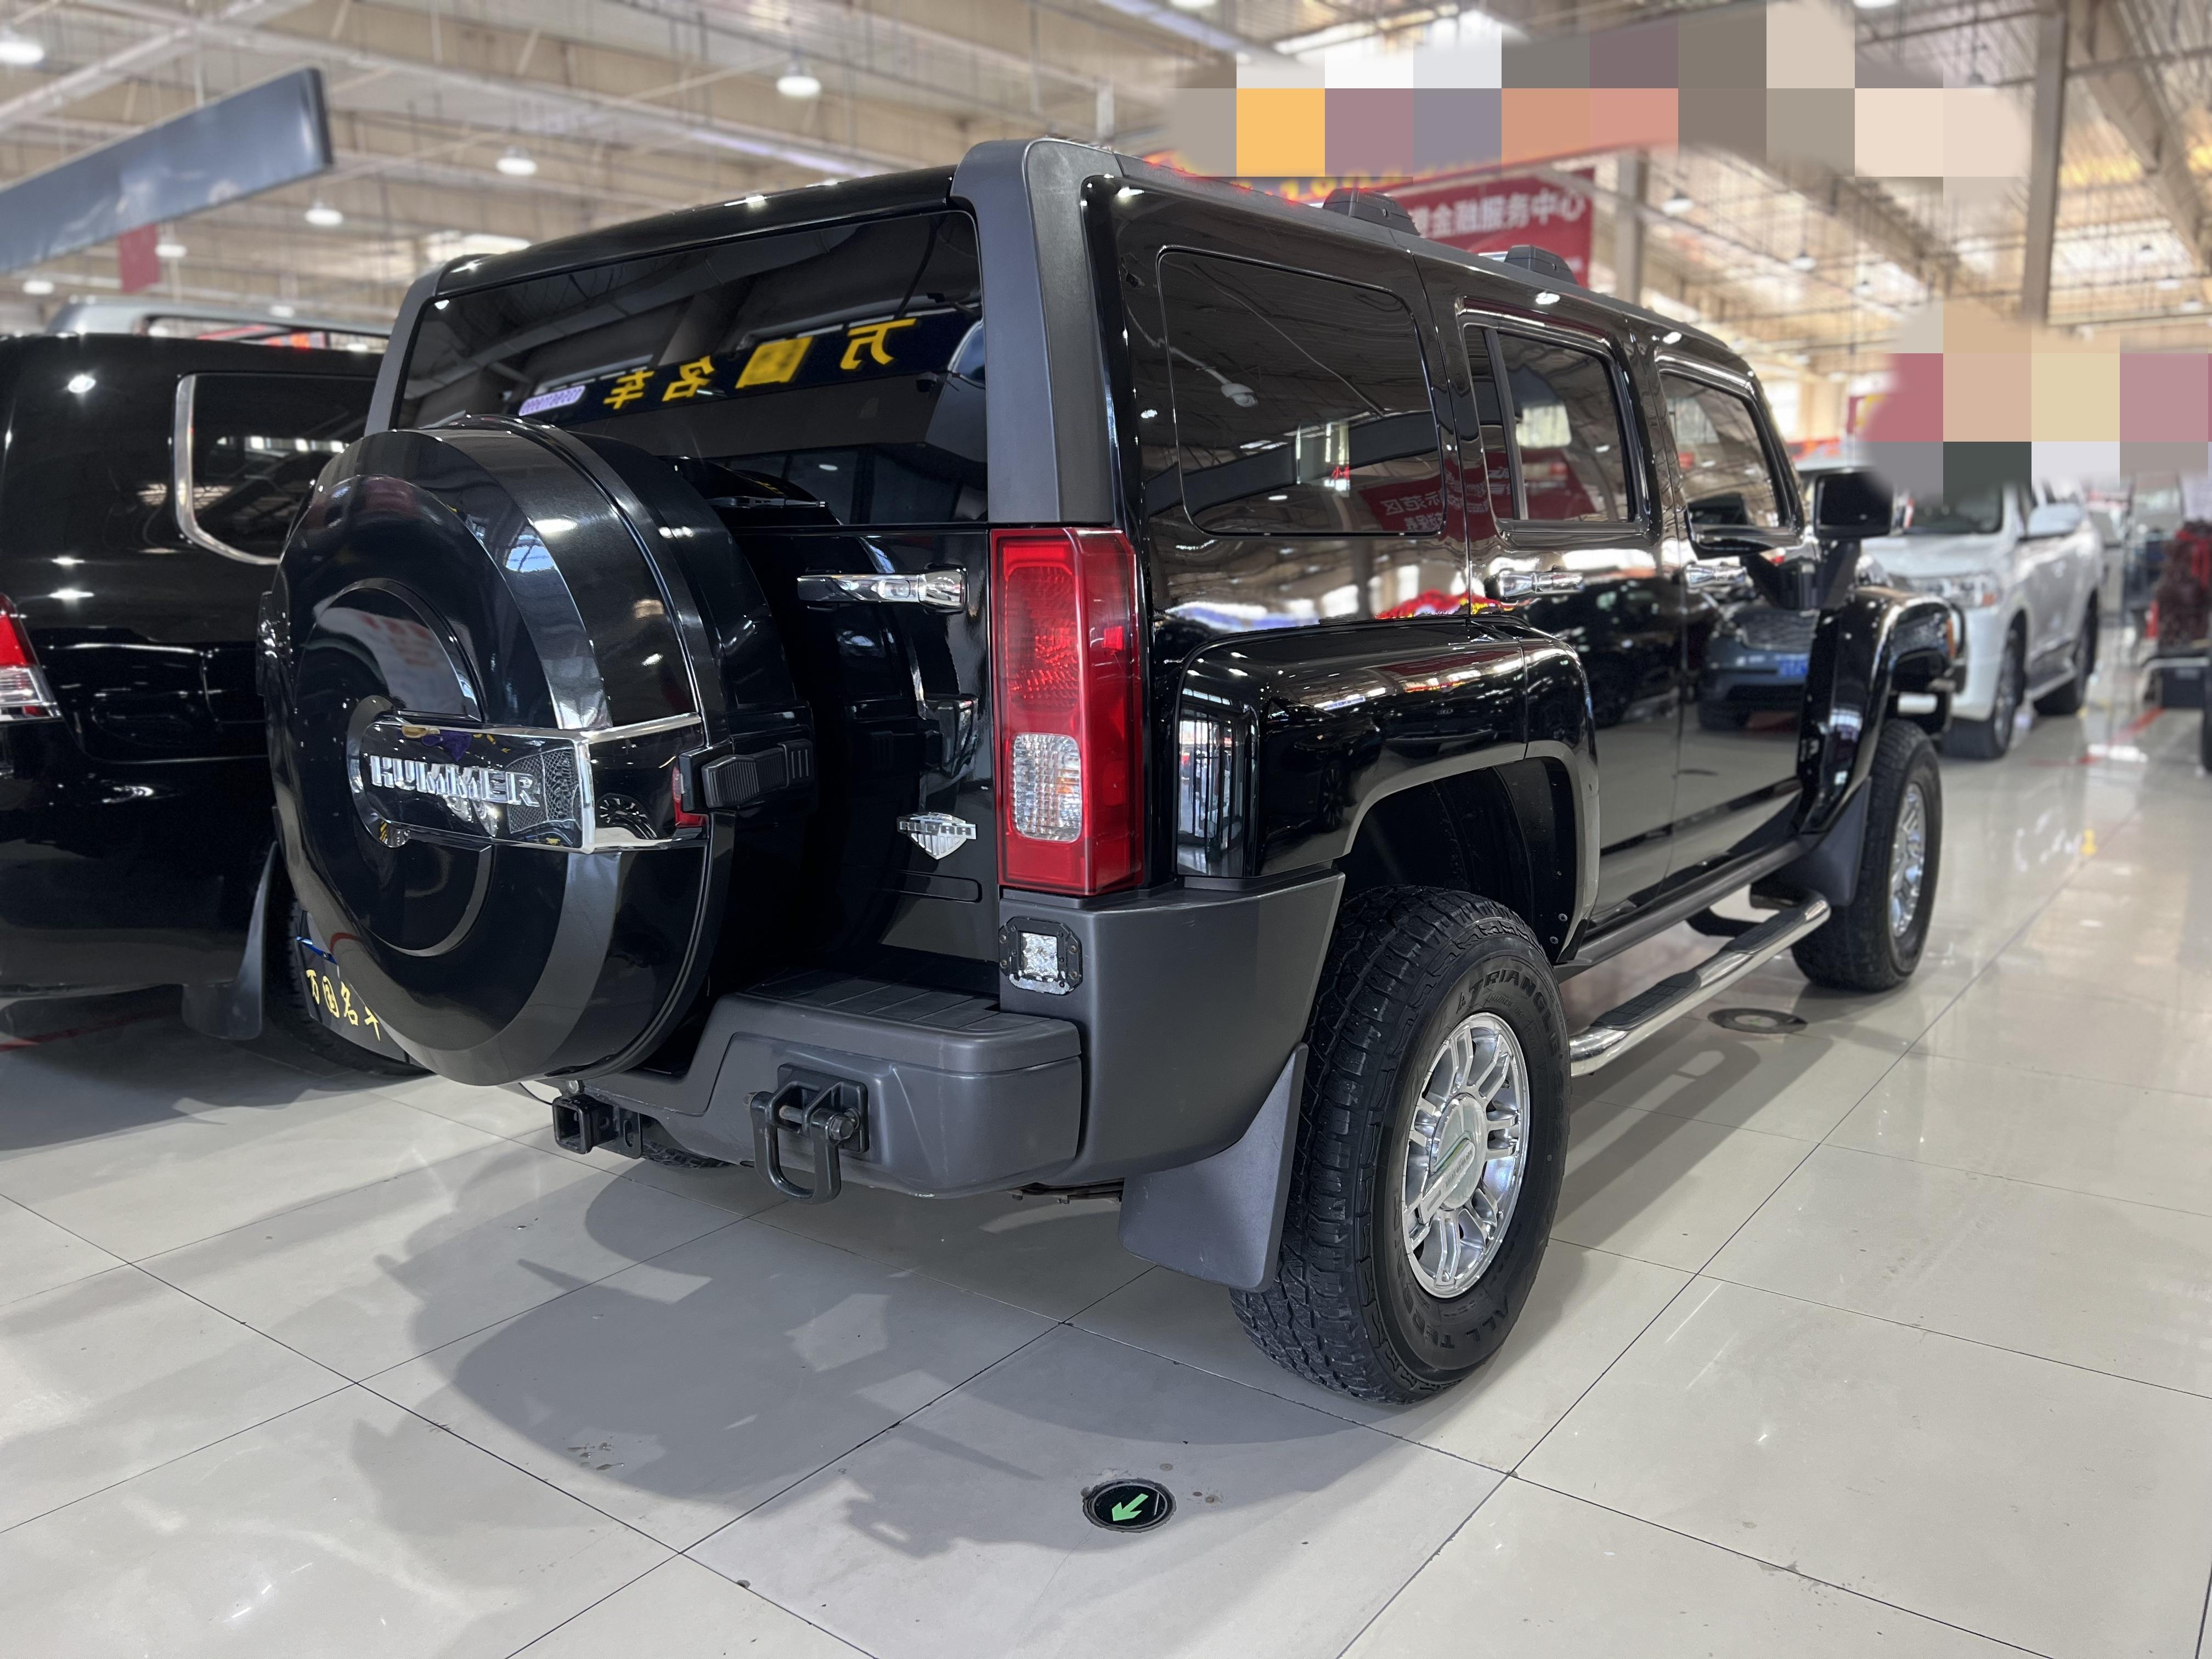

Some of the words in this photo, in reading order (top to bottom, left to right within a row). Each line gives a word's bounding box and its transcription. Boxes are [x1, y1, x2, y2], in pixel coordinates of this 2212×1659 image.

[370, 755, 541, 807] HUMMER
[1469, 969, 1560, 1055] TRIANGLE
[1465, 1296, 1509, 1344] ALL
